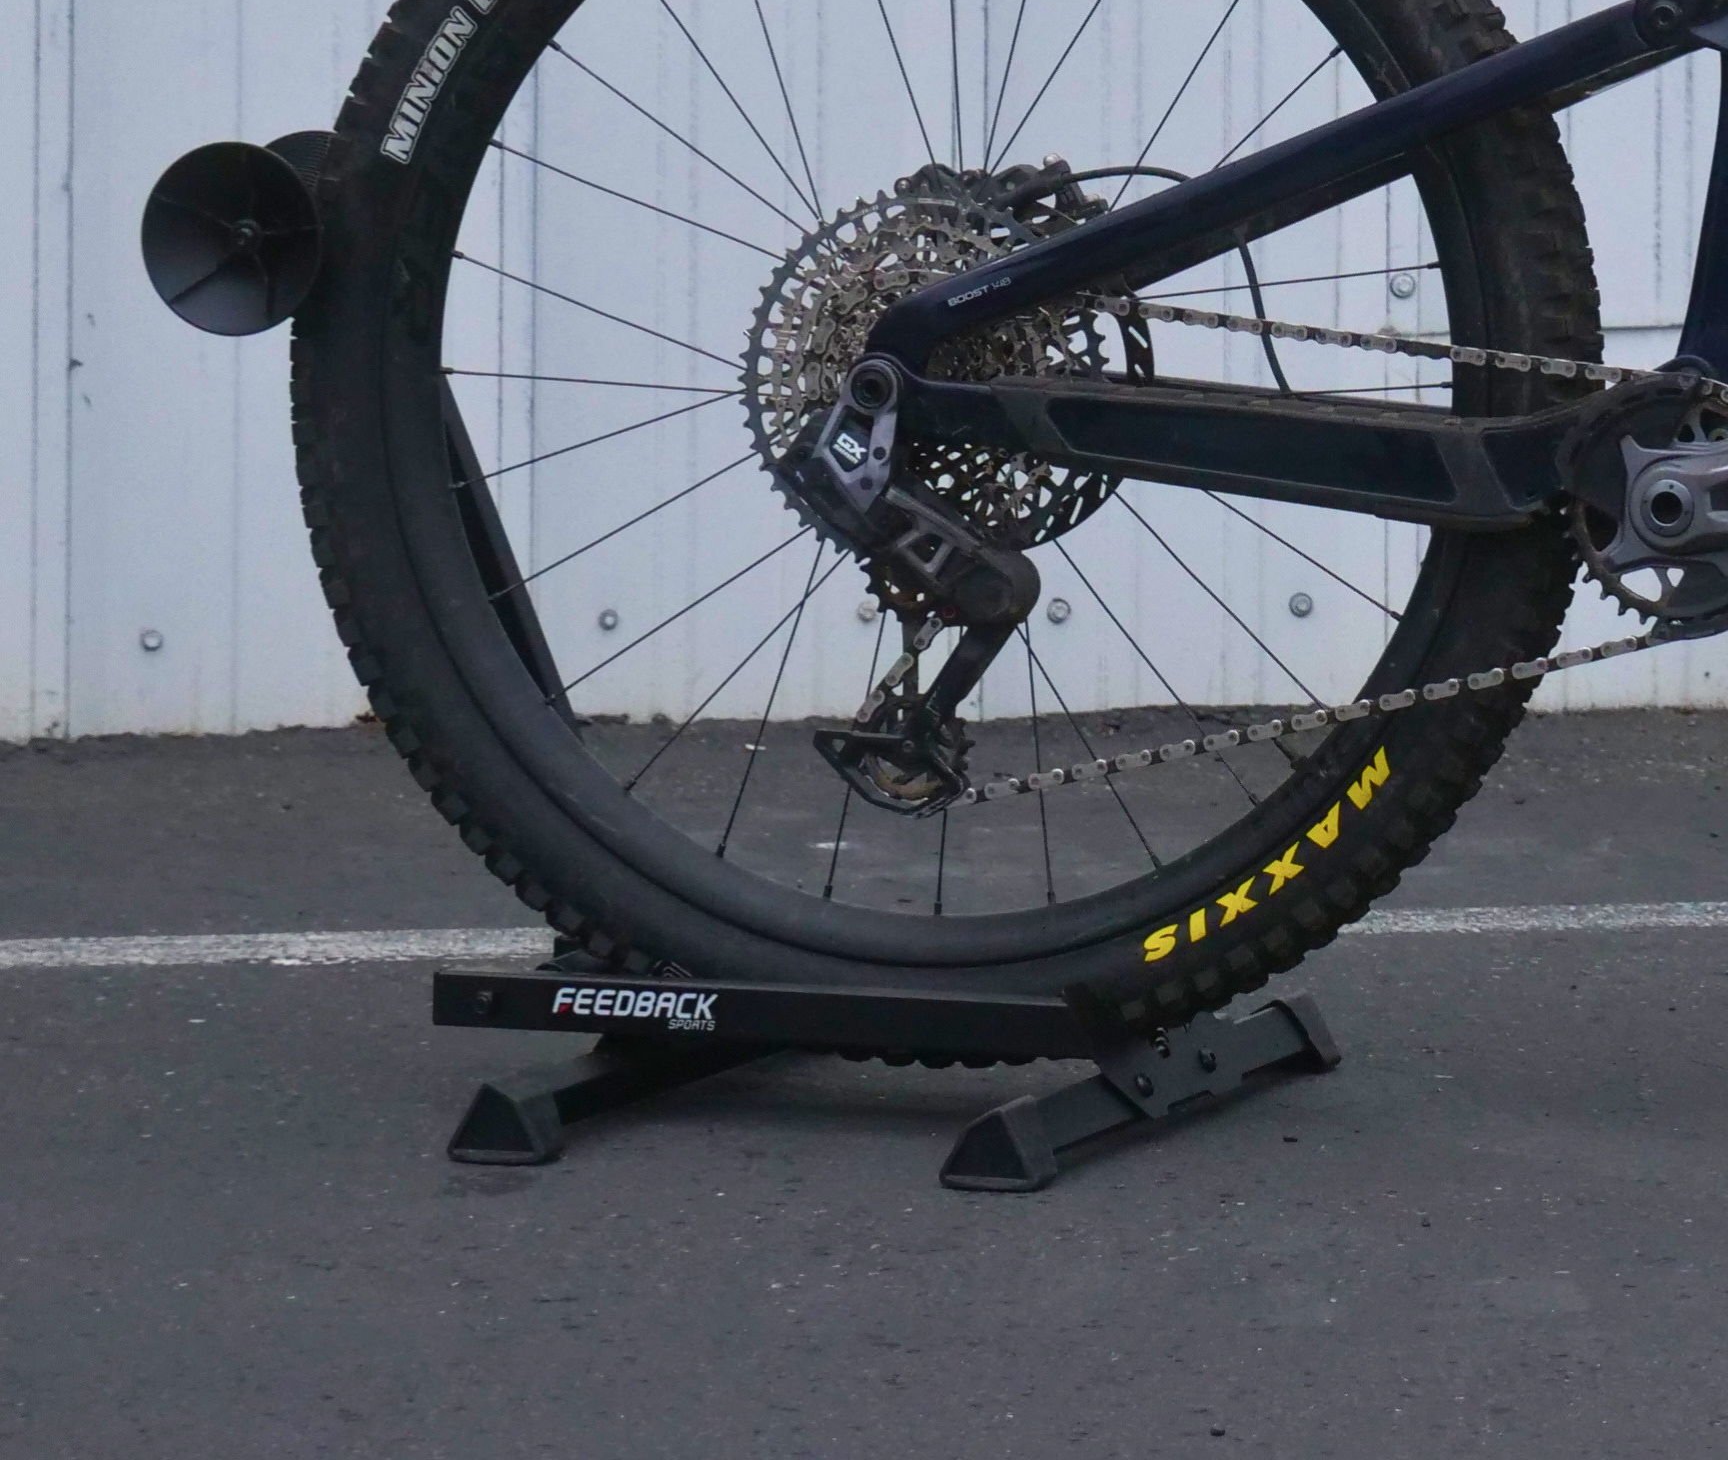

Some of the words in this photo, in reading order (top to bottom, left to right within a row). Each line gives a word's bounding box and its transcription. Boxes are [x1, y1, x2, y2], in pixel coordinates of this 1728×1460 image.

[381, 6, 478, 164] MINION
[947, 284, 989, 307] BOOST
[837, 432, 868, 460] GX
[1143, 745, 1391, 962] MAXXIS
[552, 987, 719, 1020] FEEDBACK
[668, 1018, 716, 1031] SPORTS
